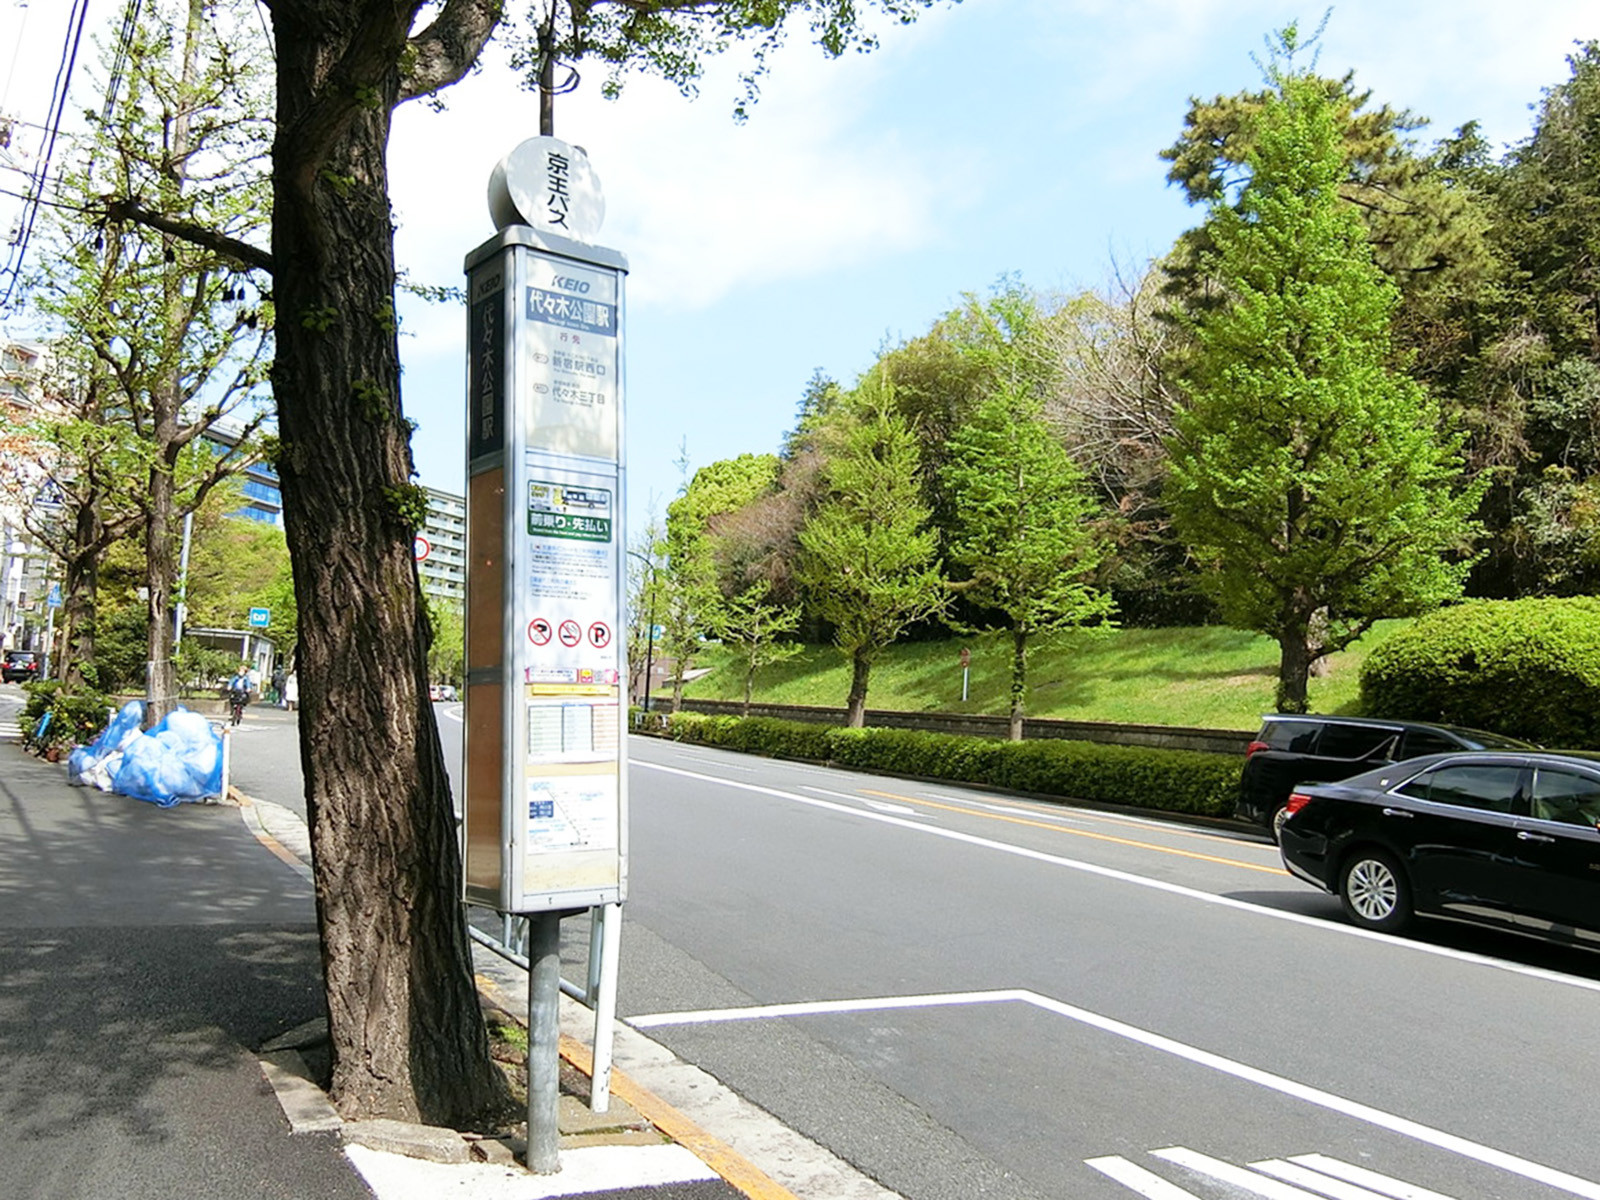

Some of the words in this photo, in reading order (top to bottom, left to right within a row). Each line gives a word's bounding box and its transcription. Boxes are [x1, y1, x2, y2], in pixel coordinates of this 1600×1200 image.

[547, 152, 570, 230] 京王バス
[529, 289, 609, 328] 代々木公園駅
[551, 275, 590, 294] KEIO
[481, 302, 495, 440] 代々木公園駅
